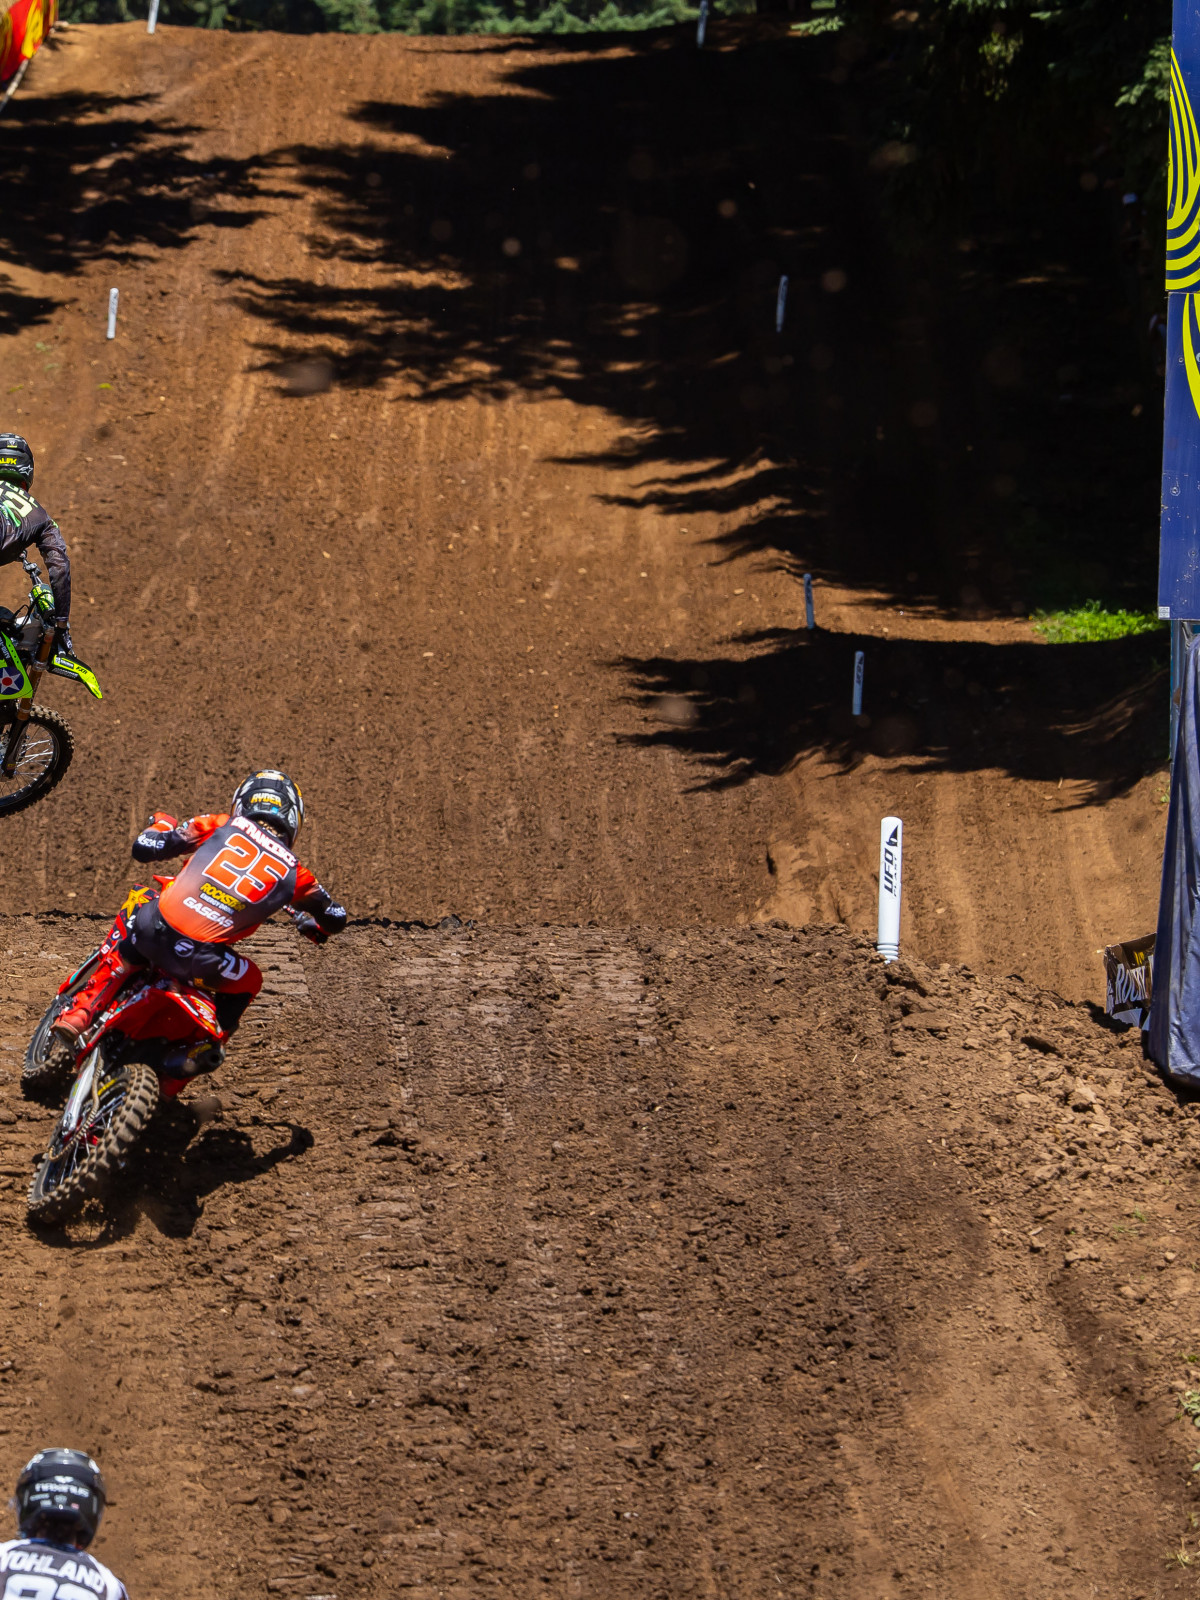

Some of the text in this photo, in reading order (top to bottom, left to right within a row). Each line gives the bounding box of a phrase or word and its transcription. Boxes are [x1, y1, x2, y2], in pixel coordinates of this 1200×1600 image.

[202, 832, 290, 904] 25
[884, 847, 894, 894] UFO
[183, 896, 234, 928] GASGAS
[0, 1550, 106, 1594] VOHLAND
